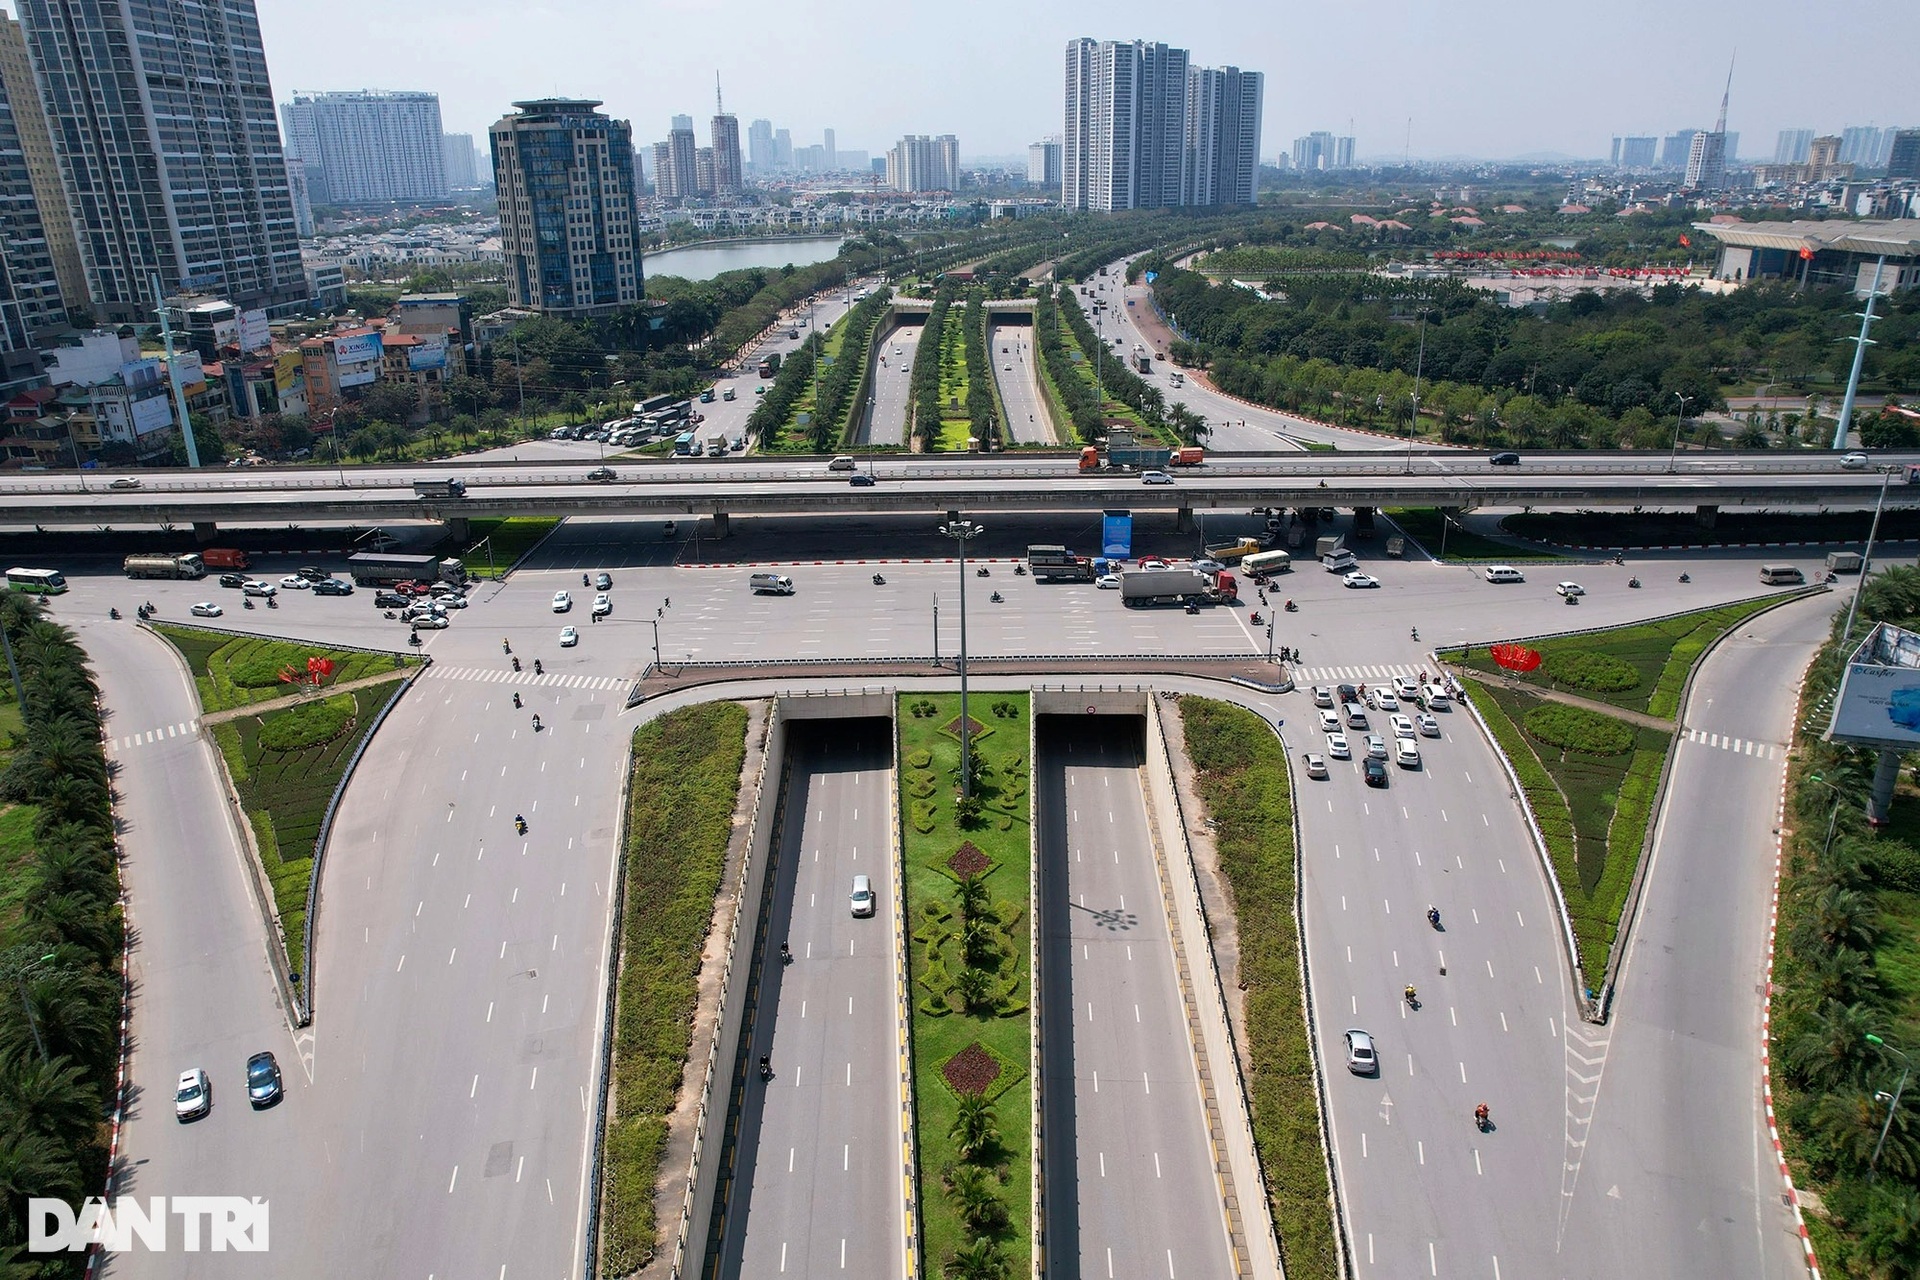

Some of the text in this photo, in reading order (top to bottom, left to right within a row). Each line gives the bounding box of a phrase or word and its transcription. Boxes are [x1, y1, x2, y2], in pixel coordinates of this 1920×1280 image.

[560, 119, 620, 129] VIGLACERA
[348, 343, 374, 351] XINGFA
[1863, 668, 1896, 677] Casper
